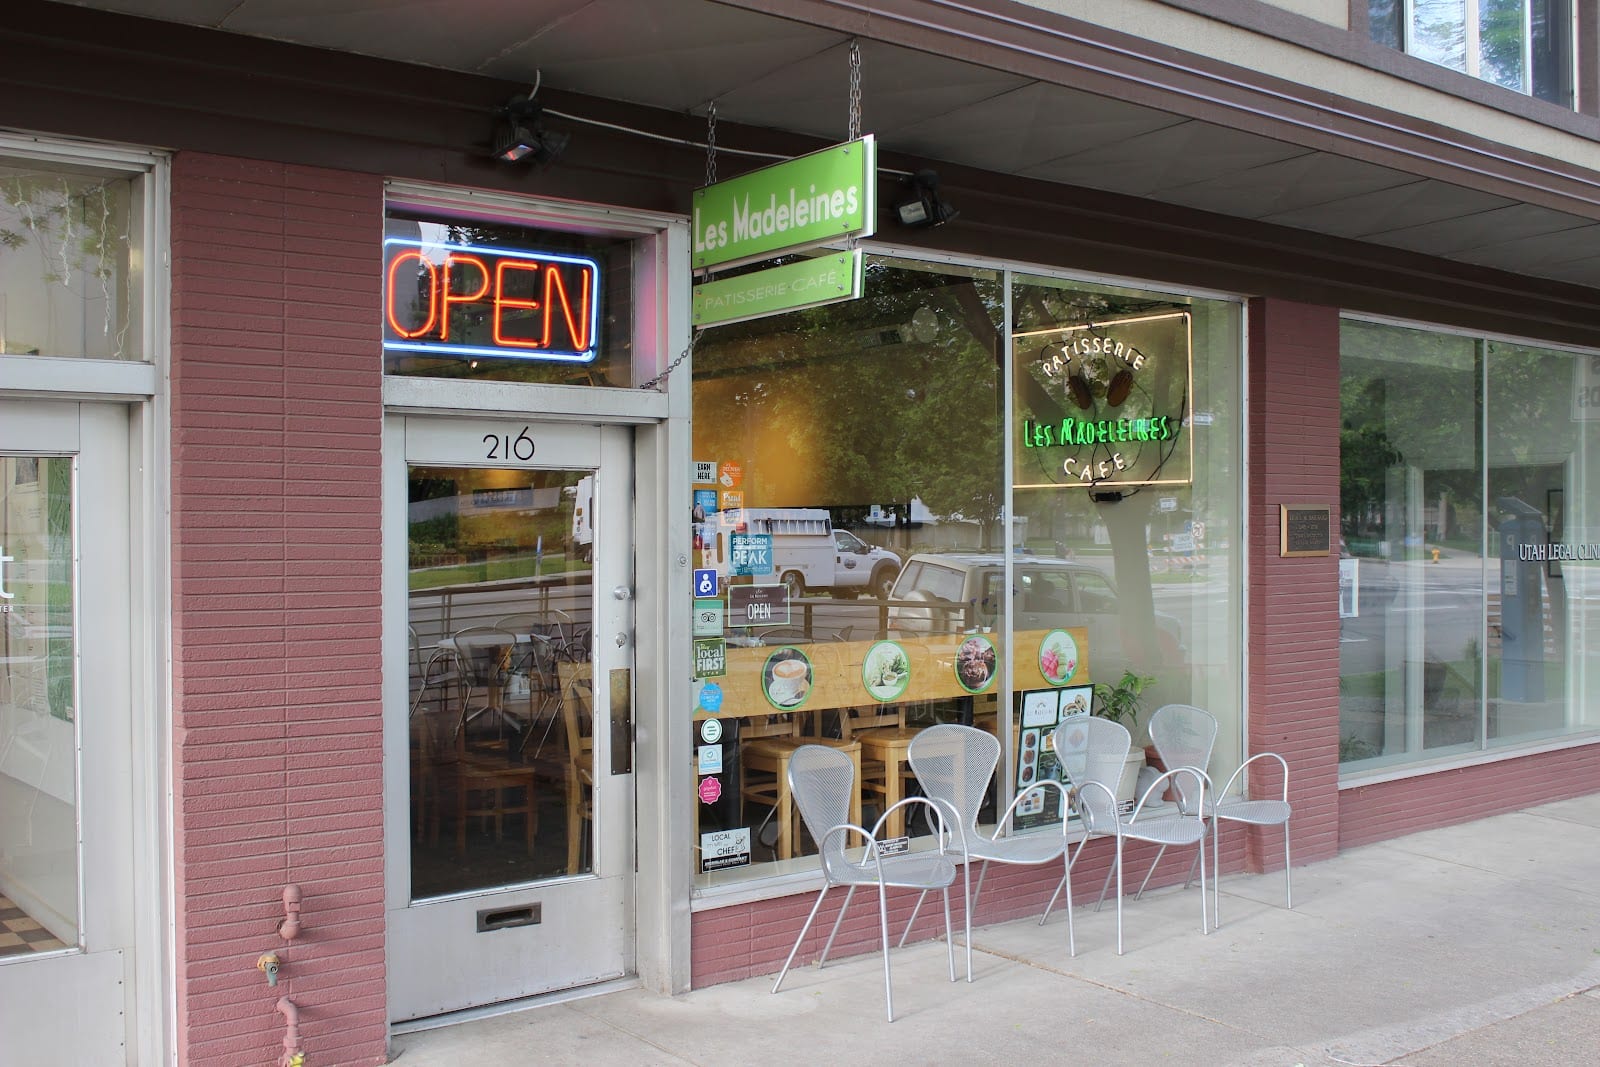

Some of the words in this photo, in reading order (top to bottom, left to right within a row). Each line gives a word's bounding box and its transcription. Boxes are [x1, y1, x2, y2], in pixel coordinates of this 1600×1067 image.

[695, 208, 727, 253] Les
[733, 184, 858, 243] Madeleines
[385, 249, 591, 351] OPEN
[705, 282, 786, 309] PATISSERIE
[1043, 338, 1145, 377] PATISSERIE
[483, 426, 535, 460] 216
[1063, 452, 1124, 481] CAFE
[732, 537, 768, 545] PERFORM
[732, 551, 768, 565] PEAK
[1519, 544, 1546, 561] UTAH
[1548, 543, 1577, 561] LEGAL
[747, 603, 771, 620] OPEN
[696, 644, 724, 659] local
[696, 657, 724, 672] FIRST
[711, 833, 731, 842] LOCAL
[716, 846, 735, 856] CHEF
